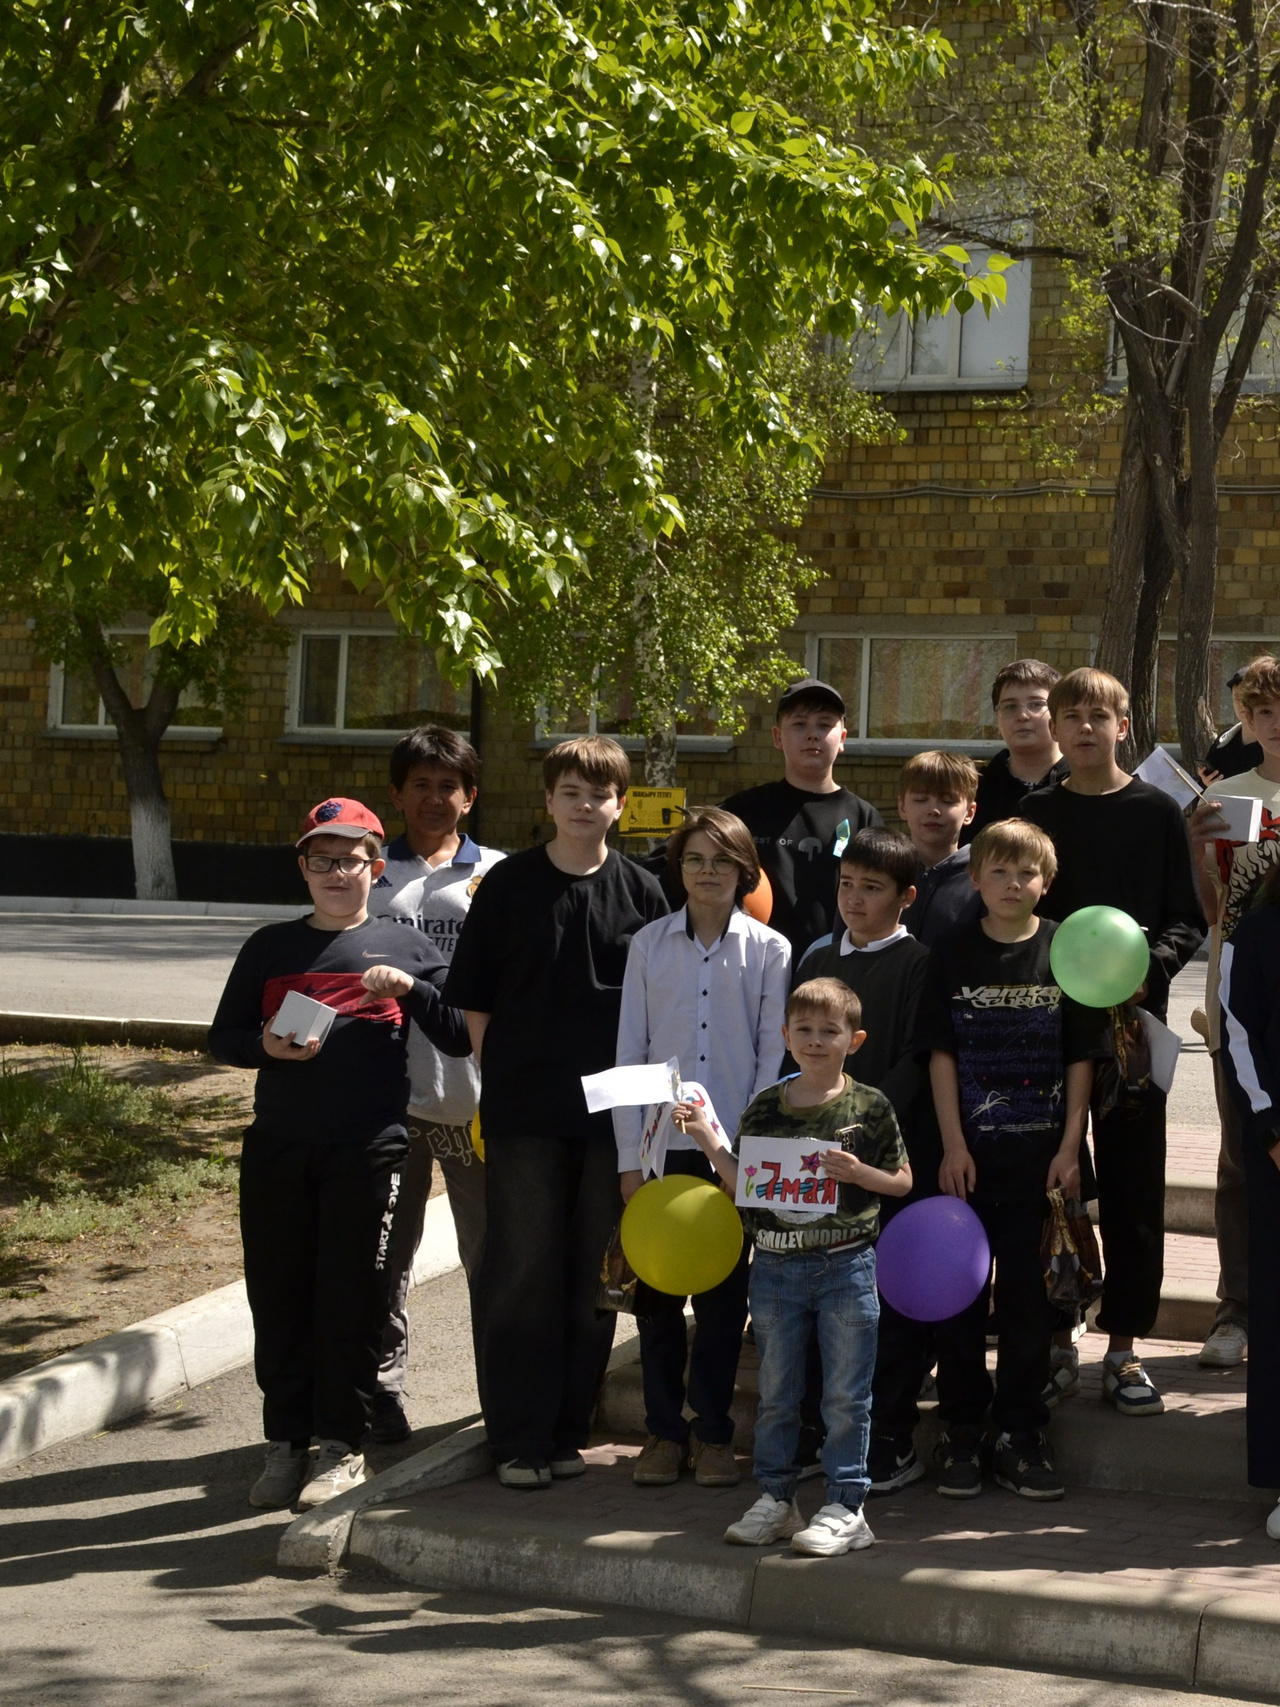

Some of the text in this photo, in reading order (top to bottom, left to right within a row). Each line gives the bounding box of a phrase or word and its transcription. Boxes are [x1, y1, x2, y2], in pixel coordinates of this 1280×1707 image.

[754, 836, 793, 846] EST OF
[761, 1160, 838, 1205] 7 мая
[375, 1227, 389, 1270] START
